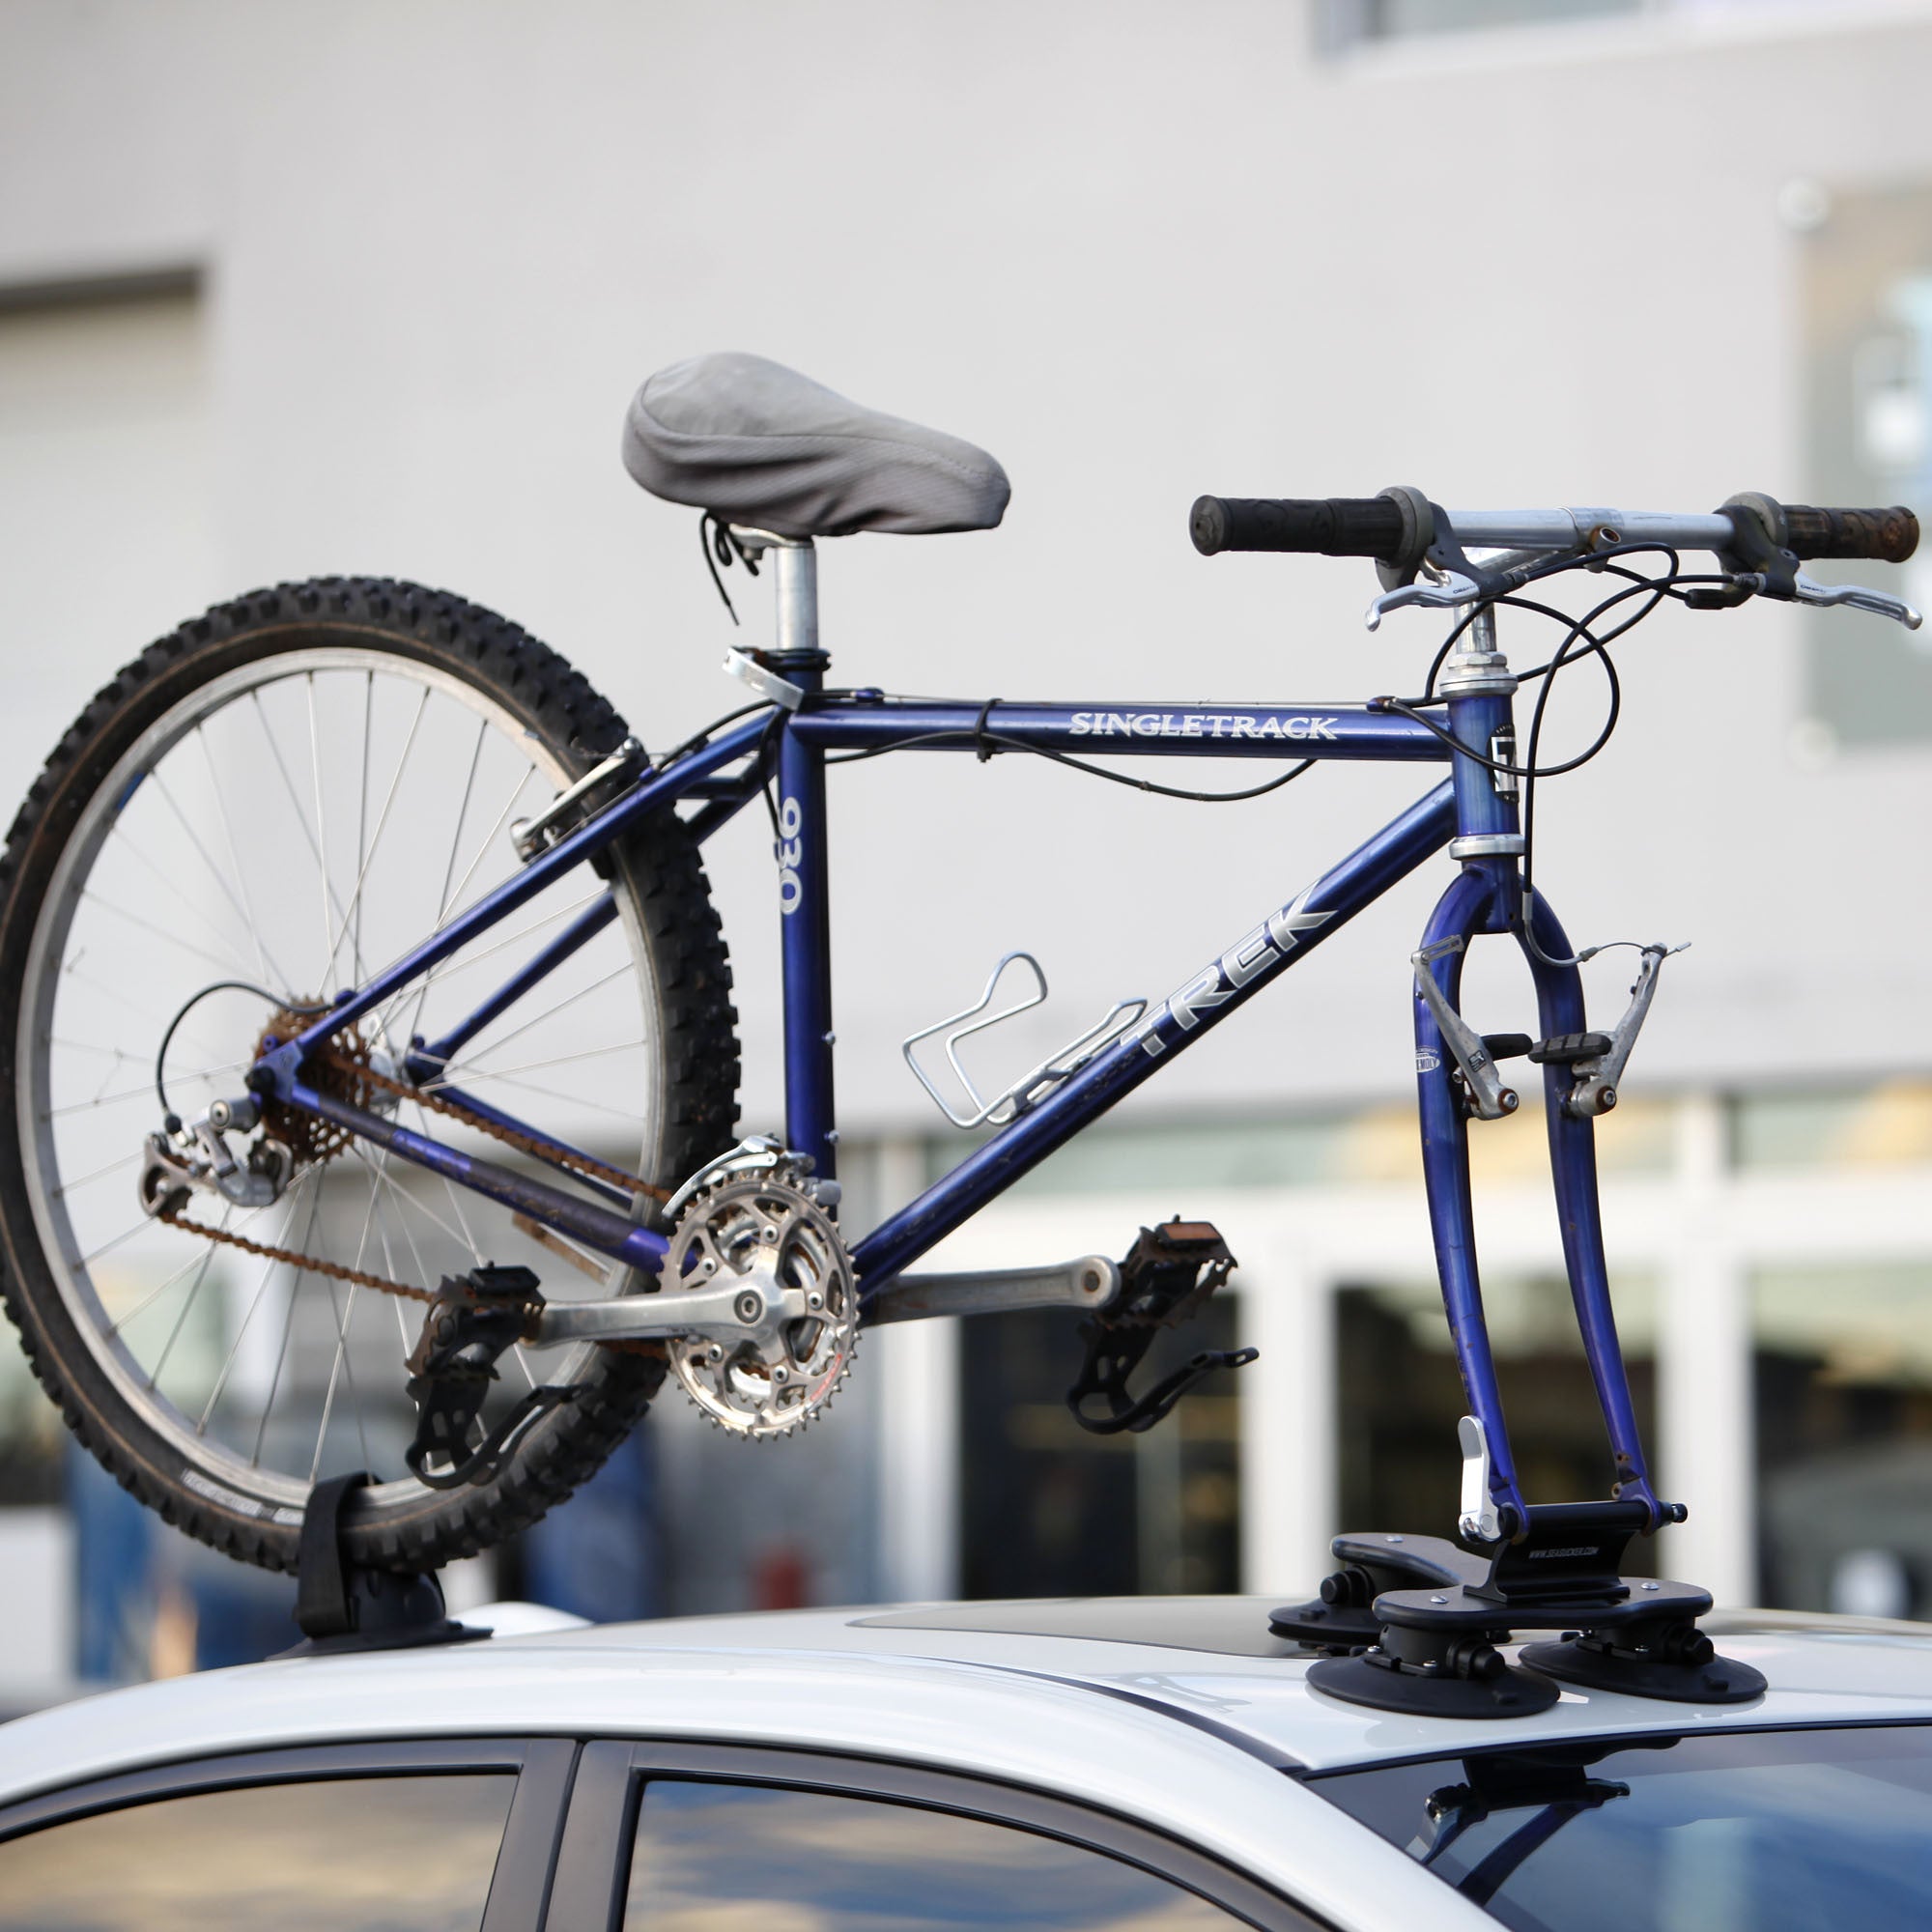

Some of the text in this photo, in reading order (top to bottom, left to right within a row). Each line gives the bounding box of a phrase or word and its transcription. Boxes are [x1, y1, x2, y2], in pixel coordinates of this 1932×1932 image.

[1068, 712, 1339, 741] SINGLETRACK
[778, 796, 803, 916] 930
[1119, 878, 1339, 1058] TREK
